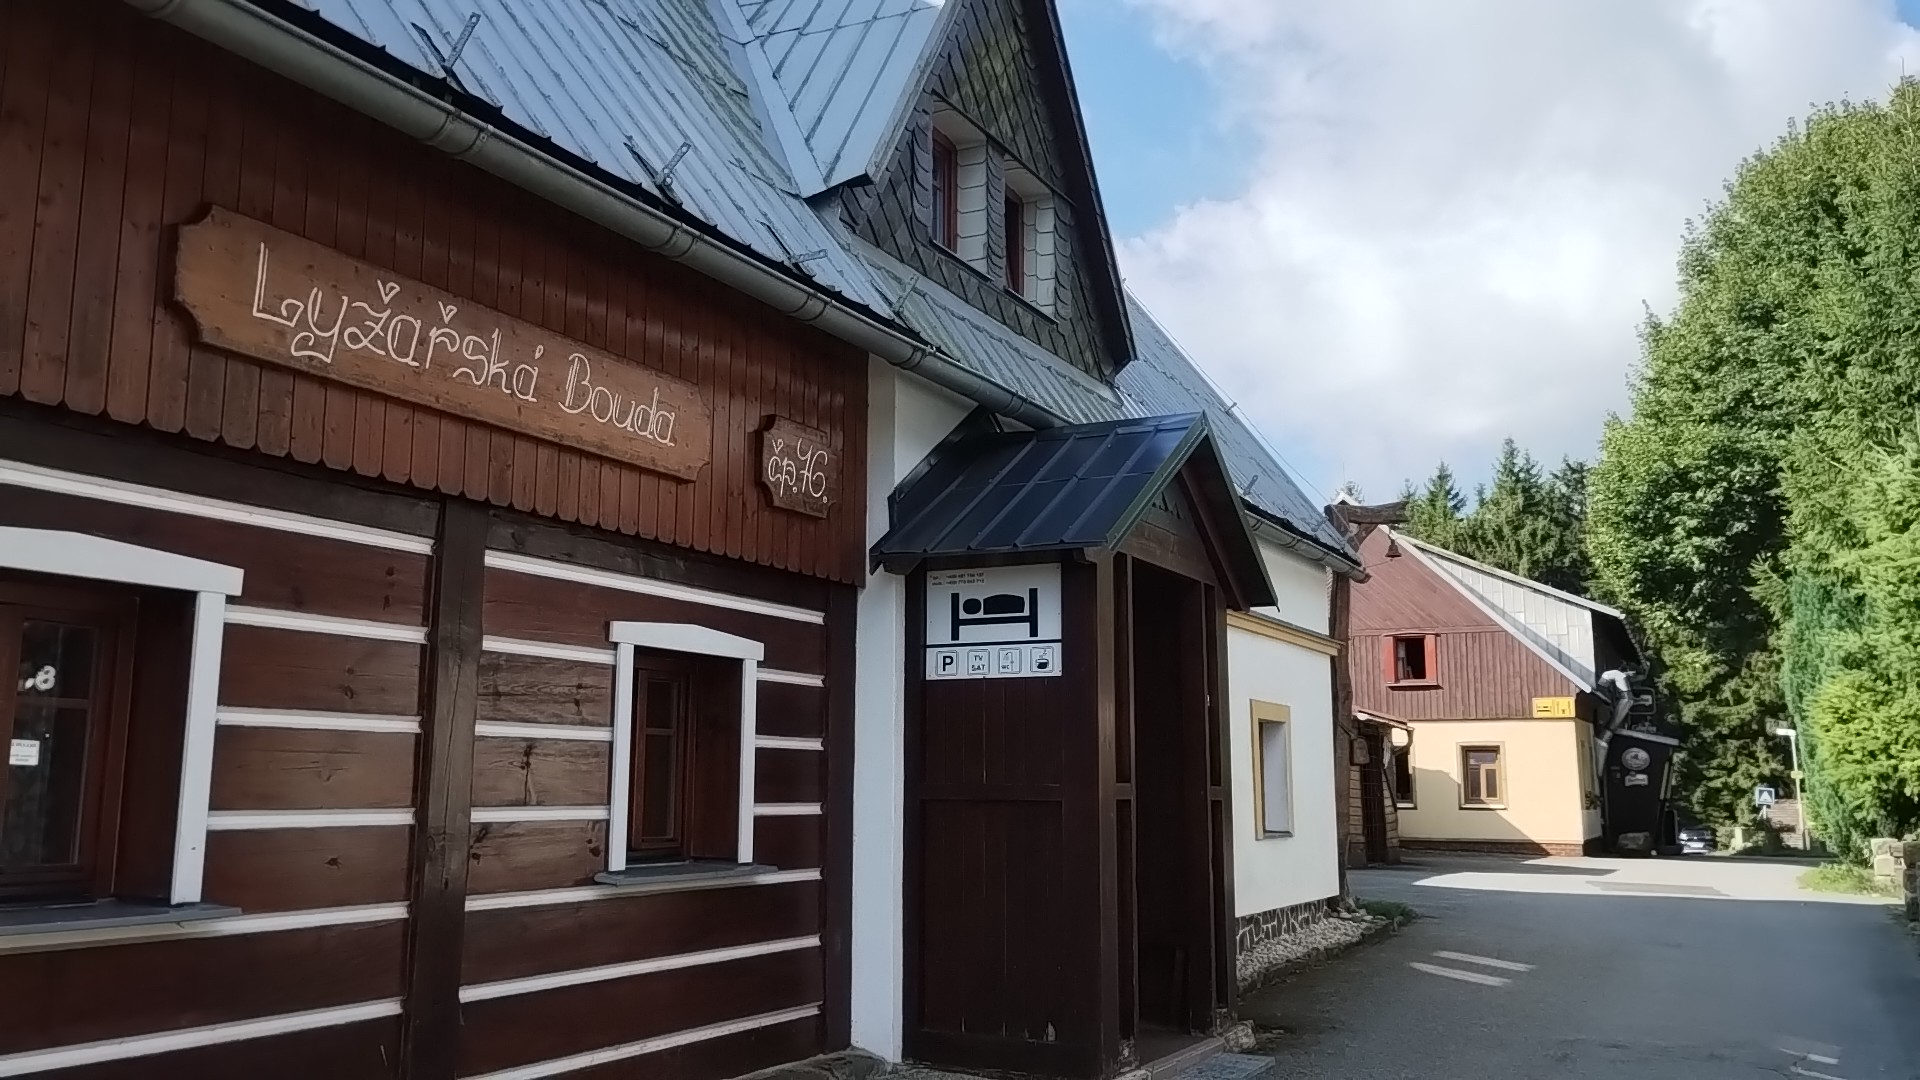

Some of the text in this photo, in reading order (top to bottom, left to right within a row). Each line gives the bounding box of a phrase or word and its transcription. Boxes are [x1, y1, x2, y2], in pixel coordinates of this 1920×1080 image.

[251, 241, 675, 448] Lyžařská Bouda
[942, 655, 954, 672] P
[971, 664, 986, 672] SAT
